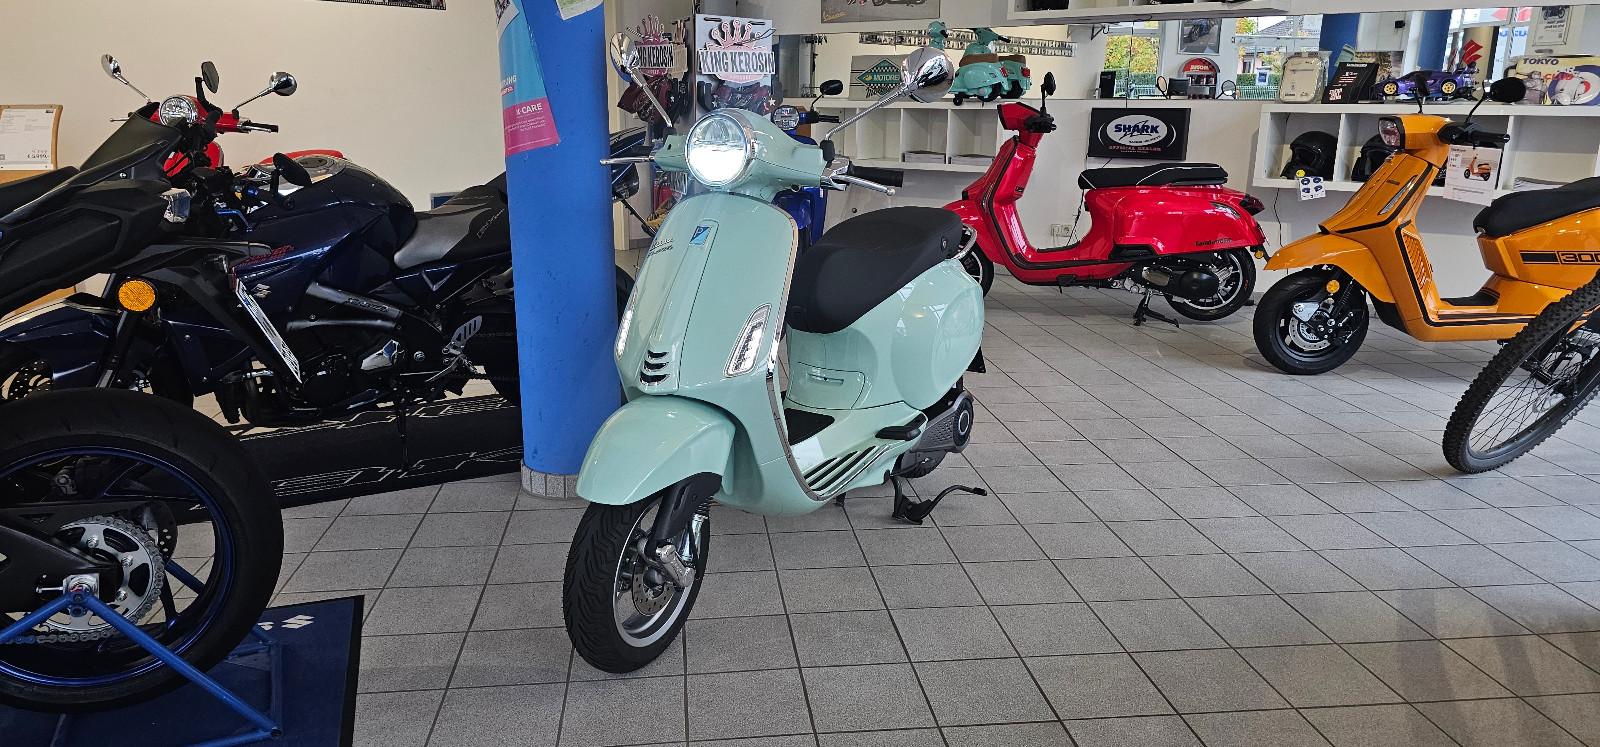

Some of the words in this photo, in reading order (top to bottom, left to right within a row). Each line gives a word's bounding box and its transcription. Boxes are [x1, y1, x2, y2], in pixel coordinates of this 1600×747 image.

[648, 44, 673, 68] KEROSIN
[700, 50, 729, 73] KING
[730, 51, 775, 73] KEROSIN
[1523, 58, 1559, 66] TOKYO
[1114, 123, 1160, 134] SHARK
